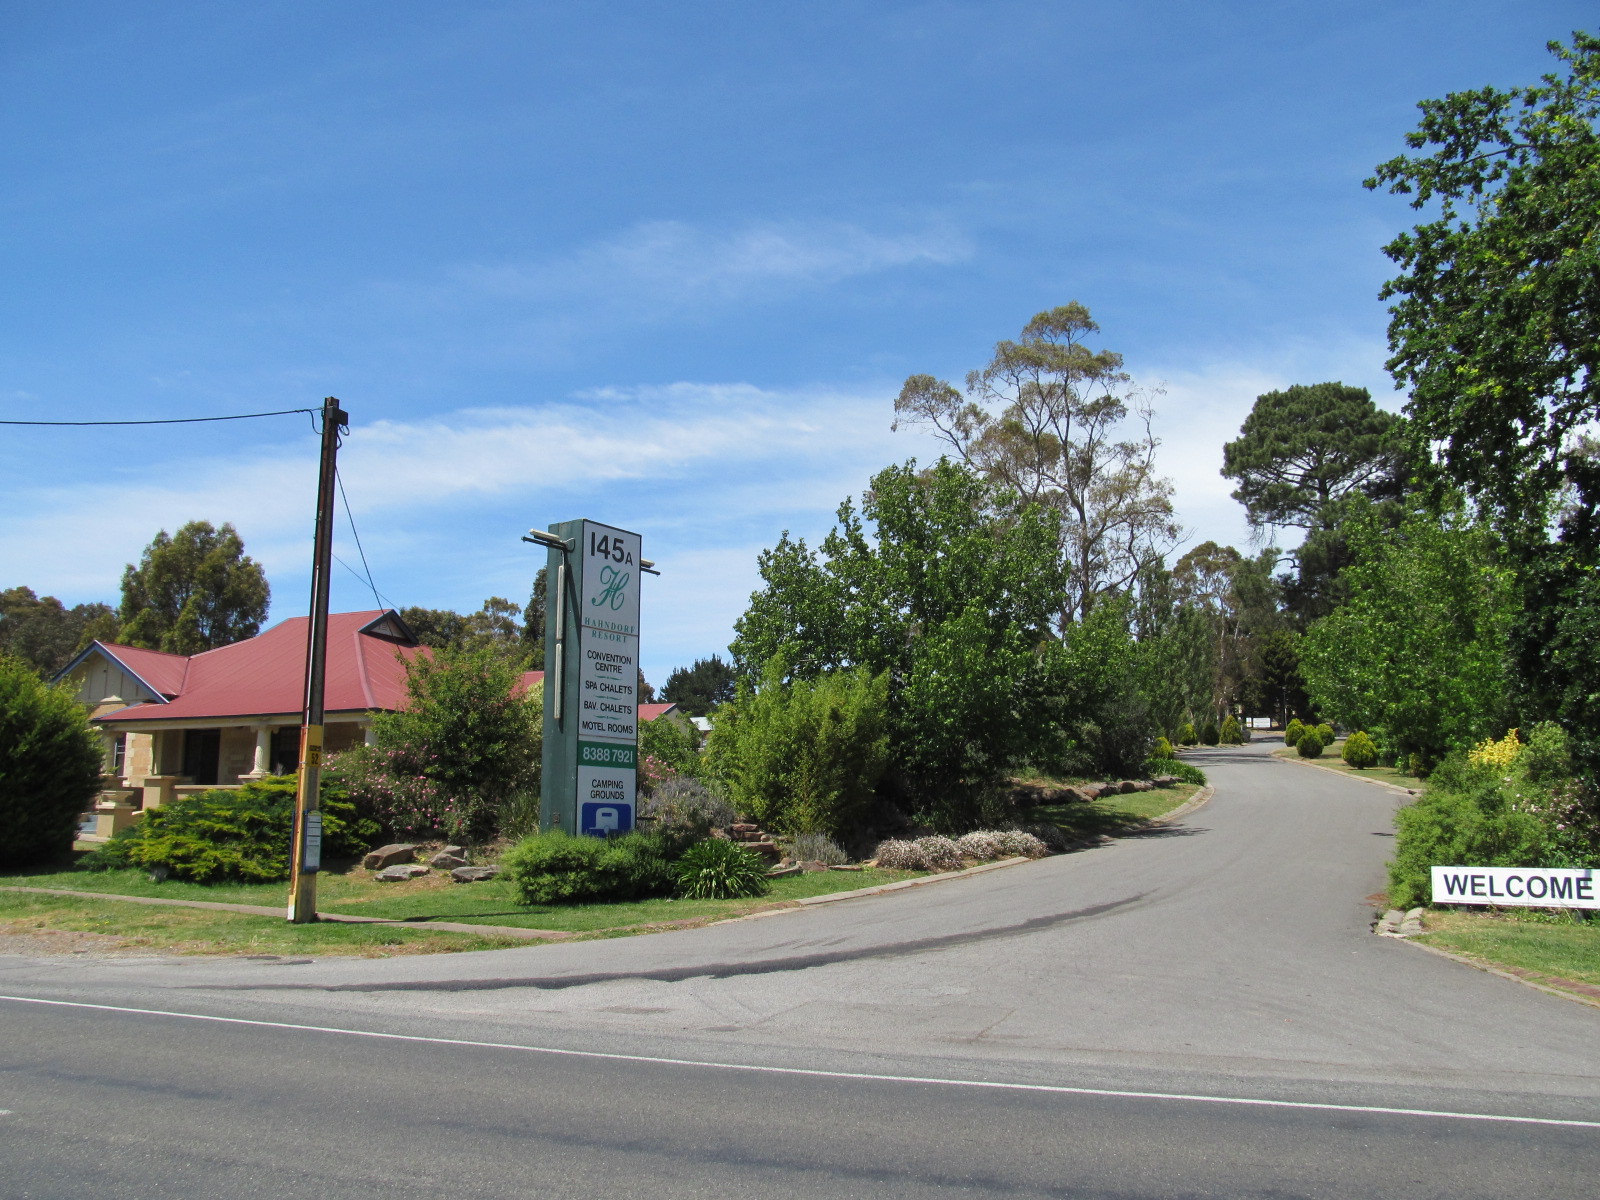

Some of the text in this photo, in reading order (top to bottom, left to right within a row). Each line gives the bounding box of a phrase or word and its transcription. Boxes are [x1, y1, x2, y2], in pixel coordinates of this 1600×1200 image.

[584, 617, 635, 634] HAHNDORF
[592, 630, 627, 643] RESORT
[587, 650, 632, 665] CONVENTION
[595, 663, 623, 674] CENTRE
[585, 680, 633, 695] SPA CHALETS
[584, 701, 632, 715] BAV. CHALETS
[582, 721, 633, 734] MOTEL ROOMS
[583, 746, 633, 763] 8388 7921
[591, 779, 624, 790] CAMPING
[590, 789, 625, 800] GROUNDS
[1443, 873, 1595, 900] WELCOME
